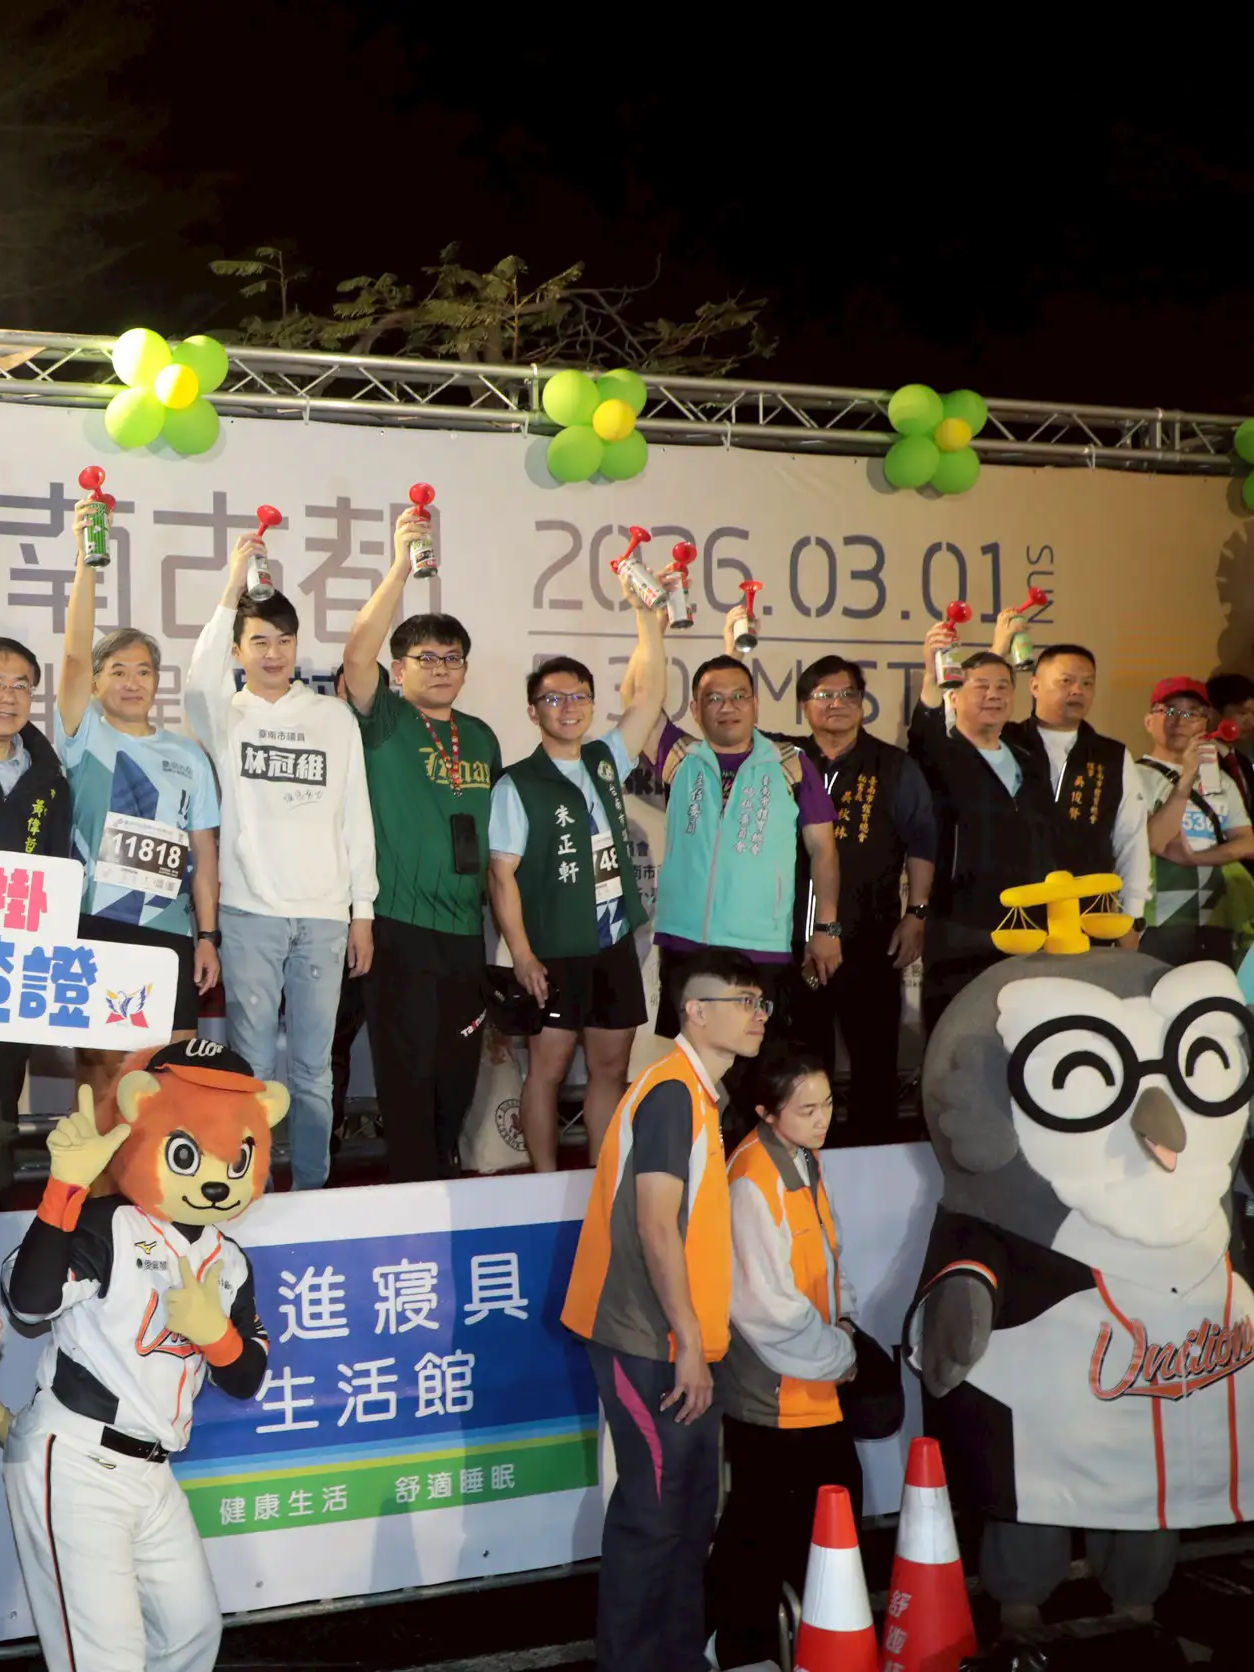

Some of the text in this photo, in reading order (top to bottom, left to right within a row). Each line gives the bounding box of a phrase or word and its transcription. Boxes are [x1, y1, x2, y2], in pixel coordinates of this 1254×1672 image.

[244, 746, 324, 781] 林冠維
[110, 832, 183, 870] 11818
[554, 804, 580, 884] 朱正軒
[278, 1251, 530, 1345] 進寢具
[255, 1349, 476, 1435] 生活館
[219, 1463, 516, 1526] 健康生活 舒適睡眠
